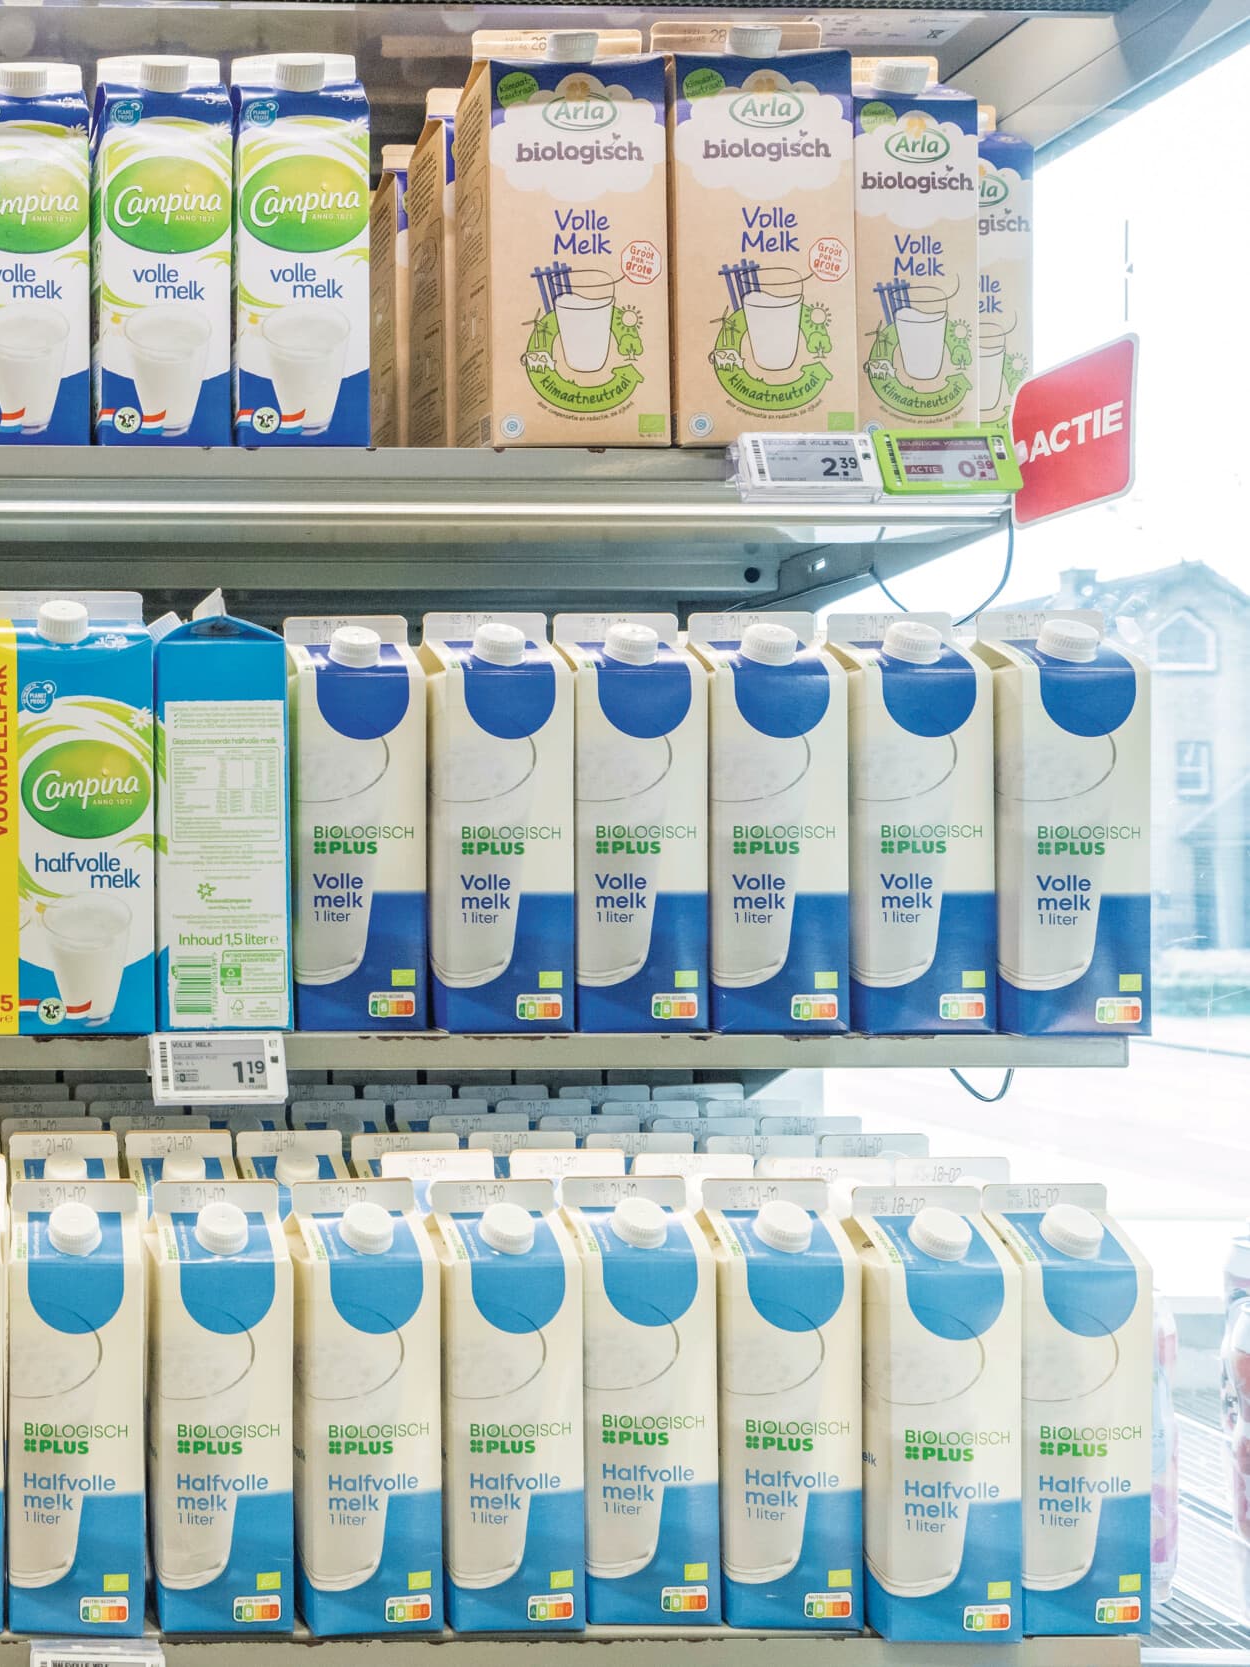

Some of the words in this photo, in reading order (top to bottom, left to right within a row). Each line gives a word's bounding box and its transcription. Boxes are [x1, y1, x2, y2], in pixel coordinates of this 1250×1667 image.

[554, 98, 604, 121] Arla
[741, 94, 792, 118] Arla
[516, 140, 644, 164] biologisch
[702, 138, 832, 162] biologisch
[895, 136, 938, 153] Arla
[861, 172, 974, 194] biologisch
[114, 184, 222, 228] Campina
[250, 184, 360, 227] Campina
[554, 208, 610, 230] Volle
[742, 206, 798, 229] Volle
[554, 234, 612, 256] Melk
[741, 230, 800, 252] Melk
[894, 234, 943, 255] Volle
[630, 245, 654, 260] Groot
[133, 263, 179, 283] volle
[270, 262, 316, 282] volle
[626, 262, 652, 276] grote
[894, 256, 945, 277] Melk
[13, 280, 62, 300] melk
[155, 280, 204, 300] melk
[293, 280, 342, 298] melk
[1029, 400, 1123, 464] ACTIE
[821, 457, 858, 476] 2.39
[910, 465, 939, 474] ACTIE
[32, 770, 140, 810] Campina
[330, 840, 378, 855] PLUS
[1054, 842, 1106, 856] PLUS
[36, 852, 120, 873] halfvolle
[91, 870, 140, 888] melk
[313, 873, 364, 890] Volle
[1036, 874, 1091, 892] Volle
[313, 892, 363, 908] melk
[1038, 894, 1091, 912] melk
[322, 910, 350, 923] liter
[1048, 912, 1078, 926] liter
[179, 932, 222, 946] Inhoud
[225, 933, 242, 946] 1,5
[245, 933, 268, 945] liter
[233, 1060, 266, 1084] 1.19
[344, 1440, 394, 1455] PLUS
[922, 1446, 974, 1462] PLUS
[328, 1473, 418, 1492] Halfvolle
[904, 1480, 1000, 1499] Halfvolle
[328, 1494, 379, 1511] melk
[904, 1500, 958, 1519] melk
